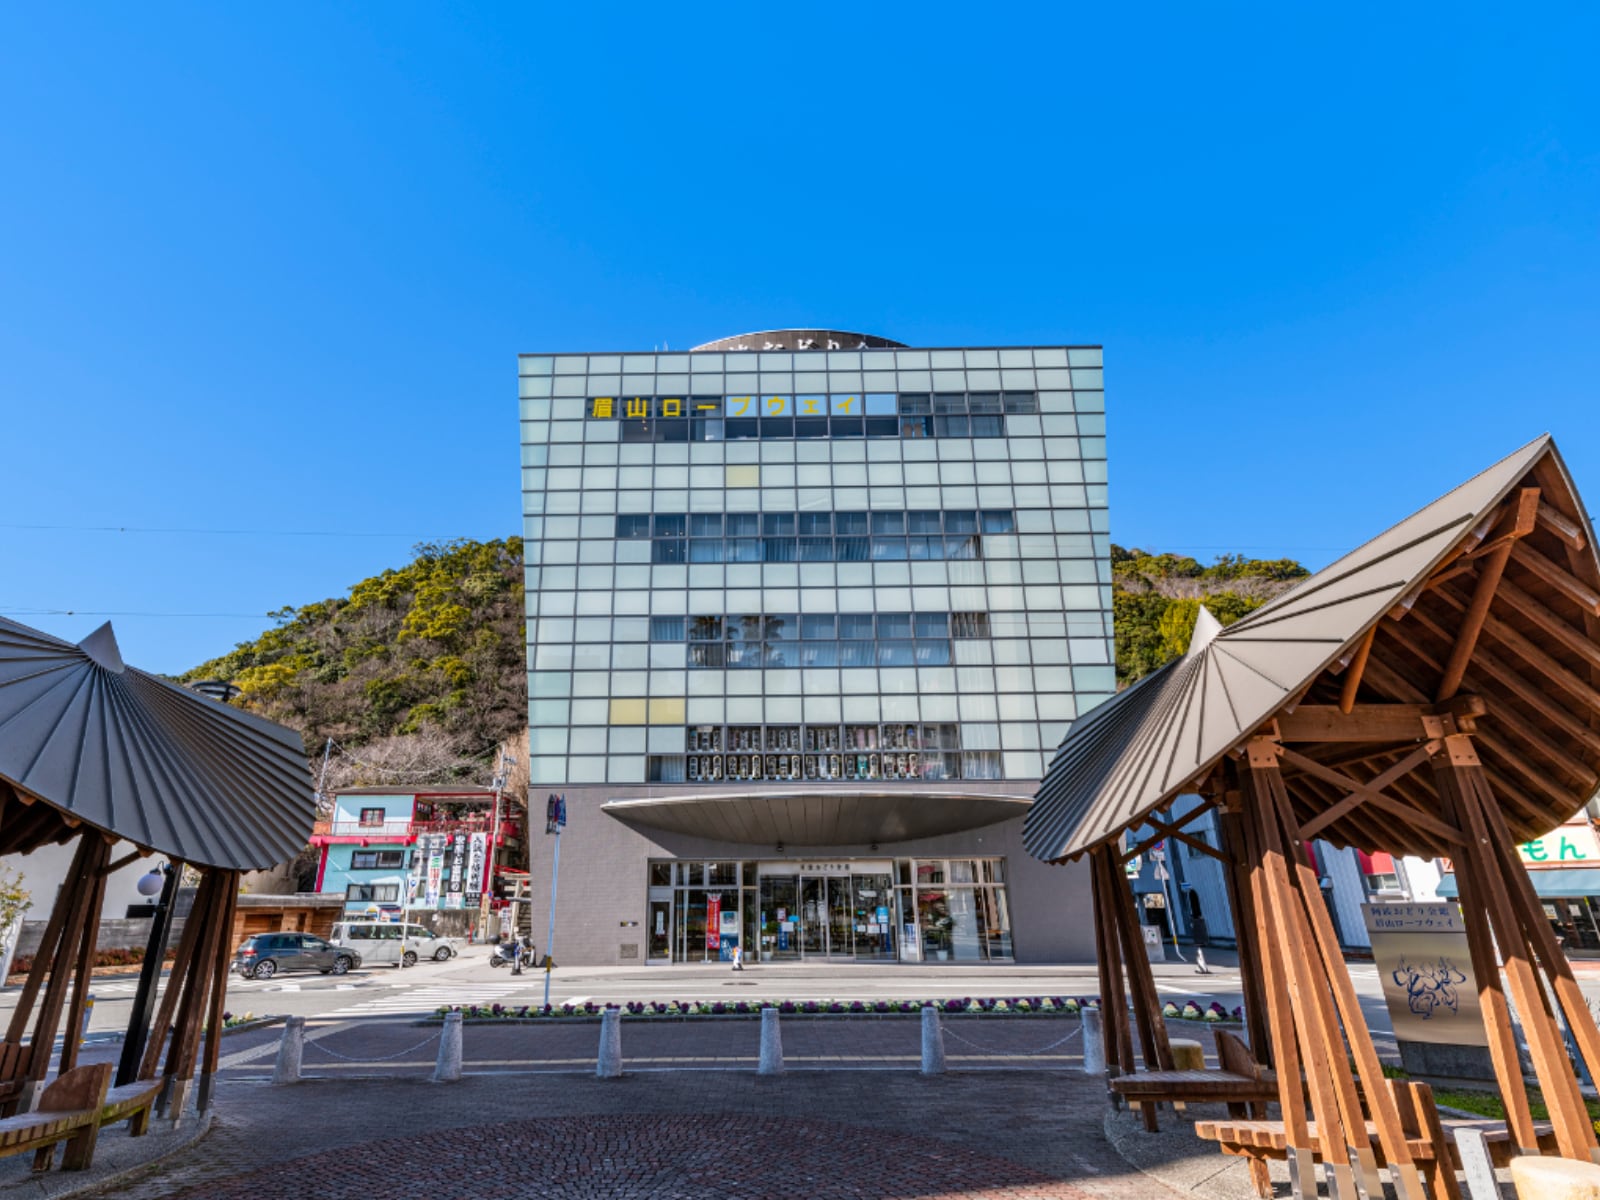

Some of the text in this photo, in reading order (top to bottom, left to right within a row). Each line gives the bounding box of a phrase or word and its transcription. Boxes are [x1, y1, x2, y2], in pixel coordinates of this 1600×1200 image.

[592, 396, 854, 418] 眉山ロープウェイ
[1522, 836, 1586, 860] もん
